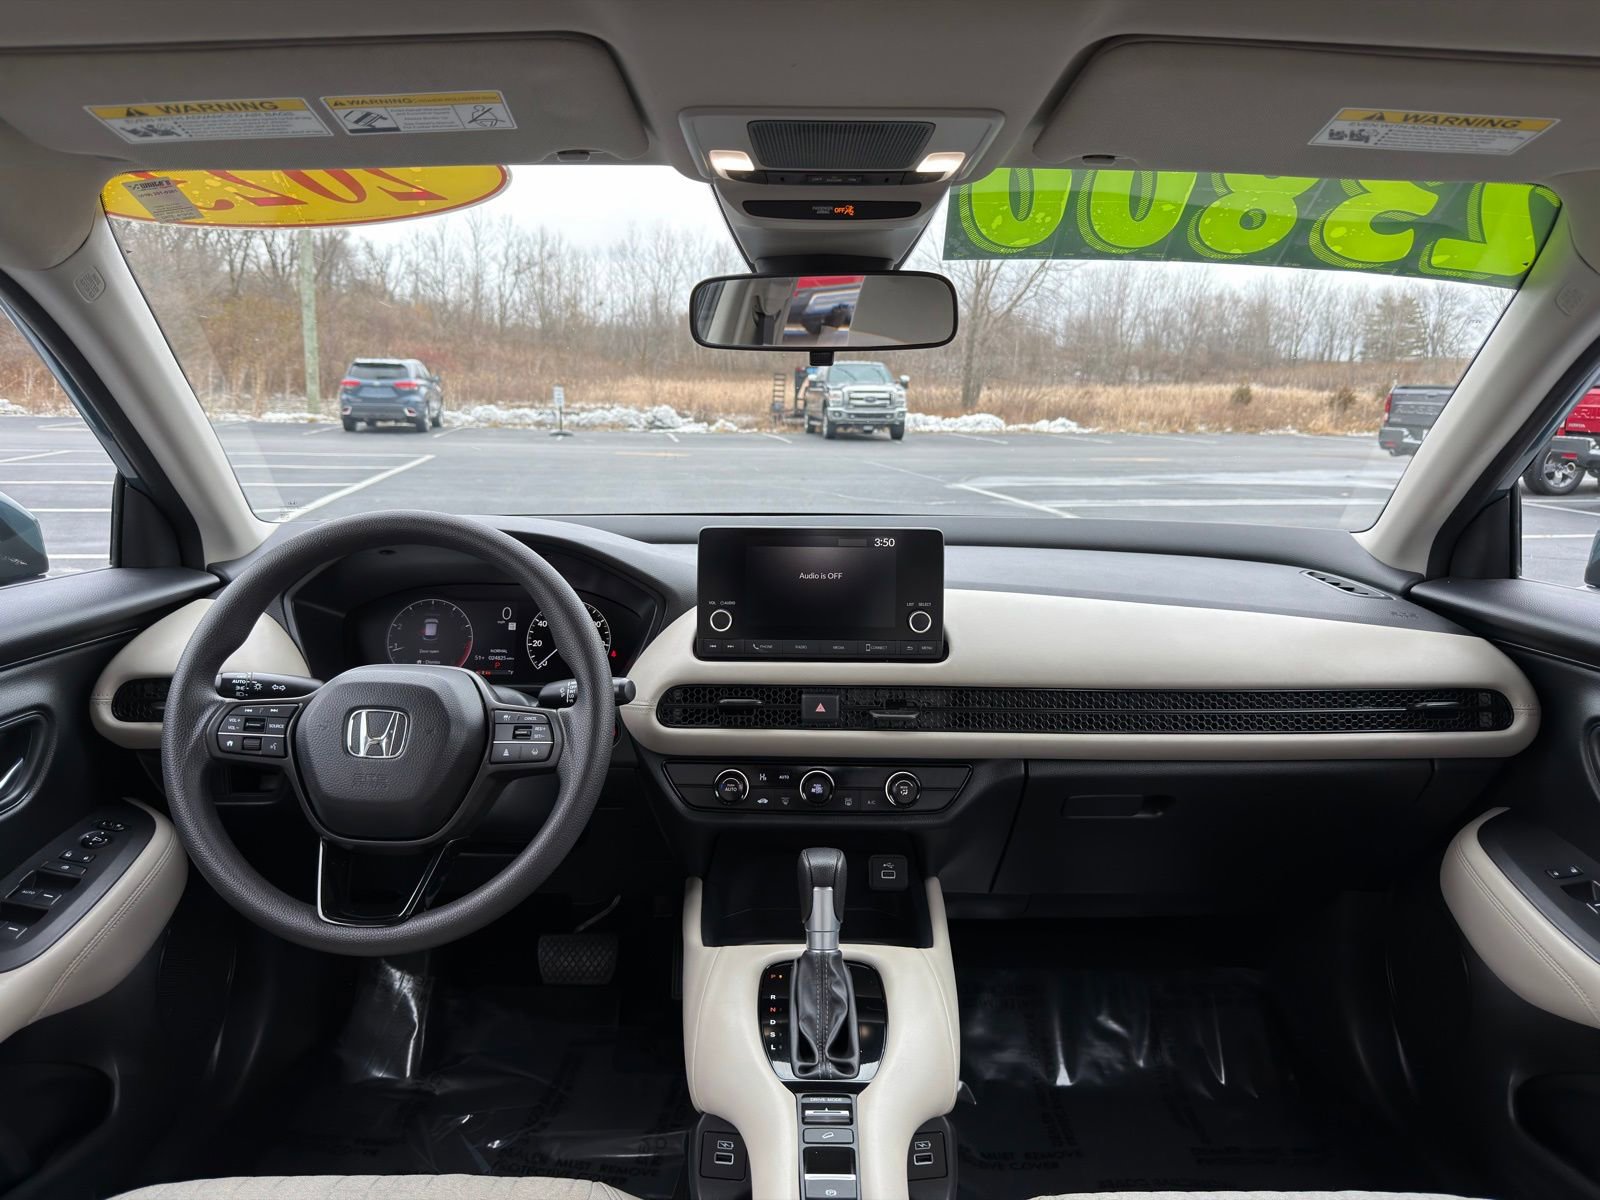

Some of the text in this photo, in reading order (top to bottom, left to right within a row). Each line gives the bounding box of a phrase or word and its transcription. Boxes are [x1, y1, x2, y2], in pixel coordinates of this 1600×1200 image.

[155, 101, 279, 114] WARNING
[1402, 114, 1522, 129] WARNING
[874, 538, 896, 547] 3:50
[799, 572, 842, 580] Audio is OFF
[502, 606, 512, 620] 0
[556, 1158, 592, 1170] MUST
[600, 1163, 661, 1177] REMOVE
